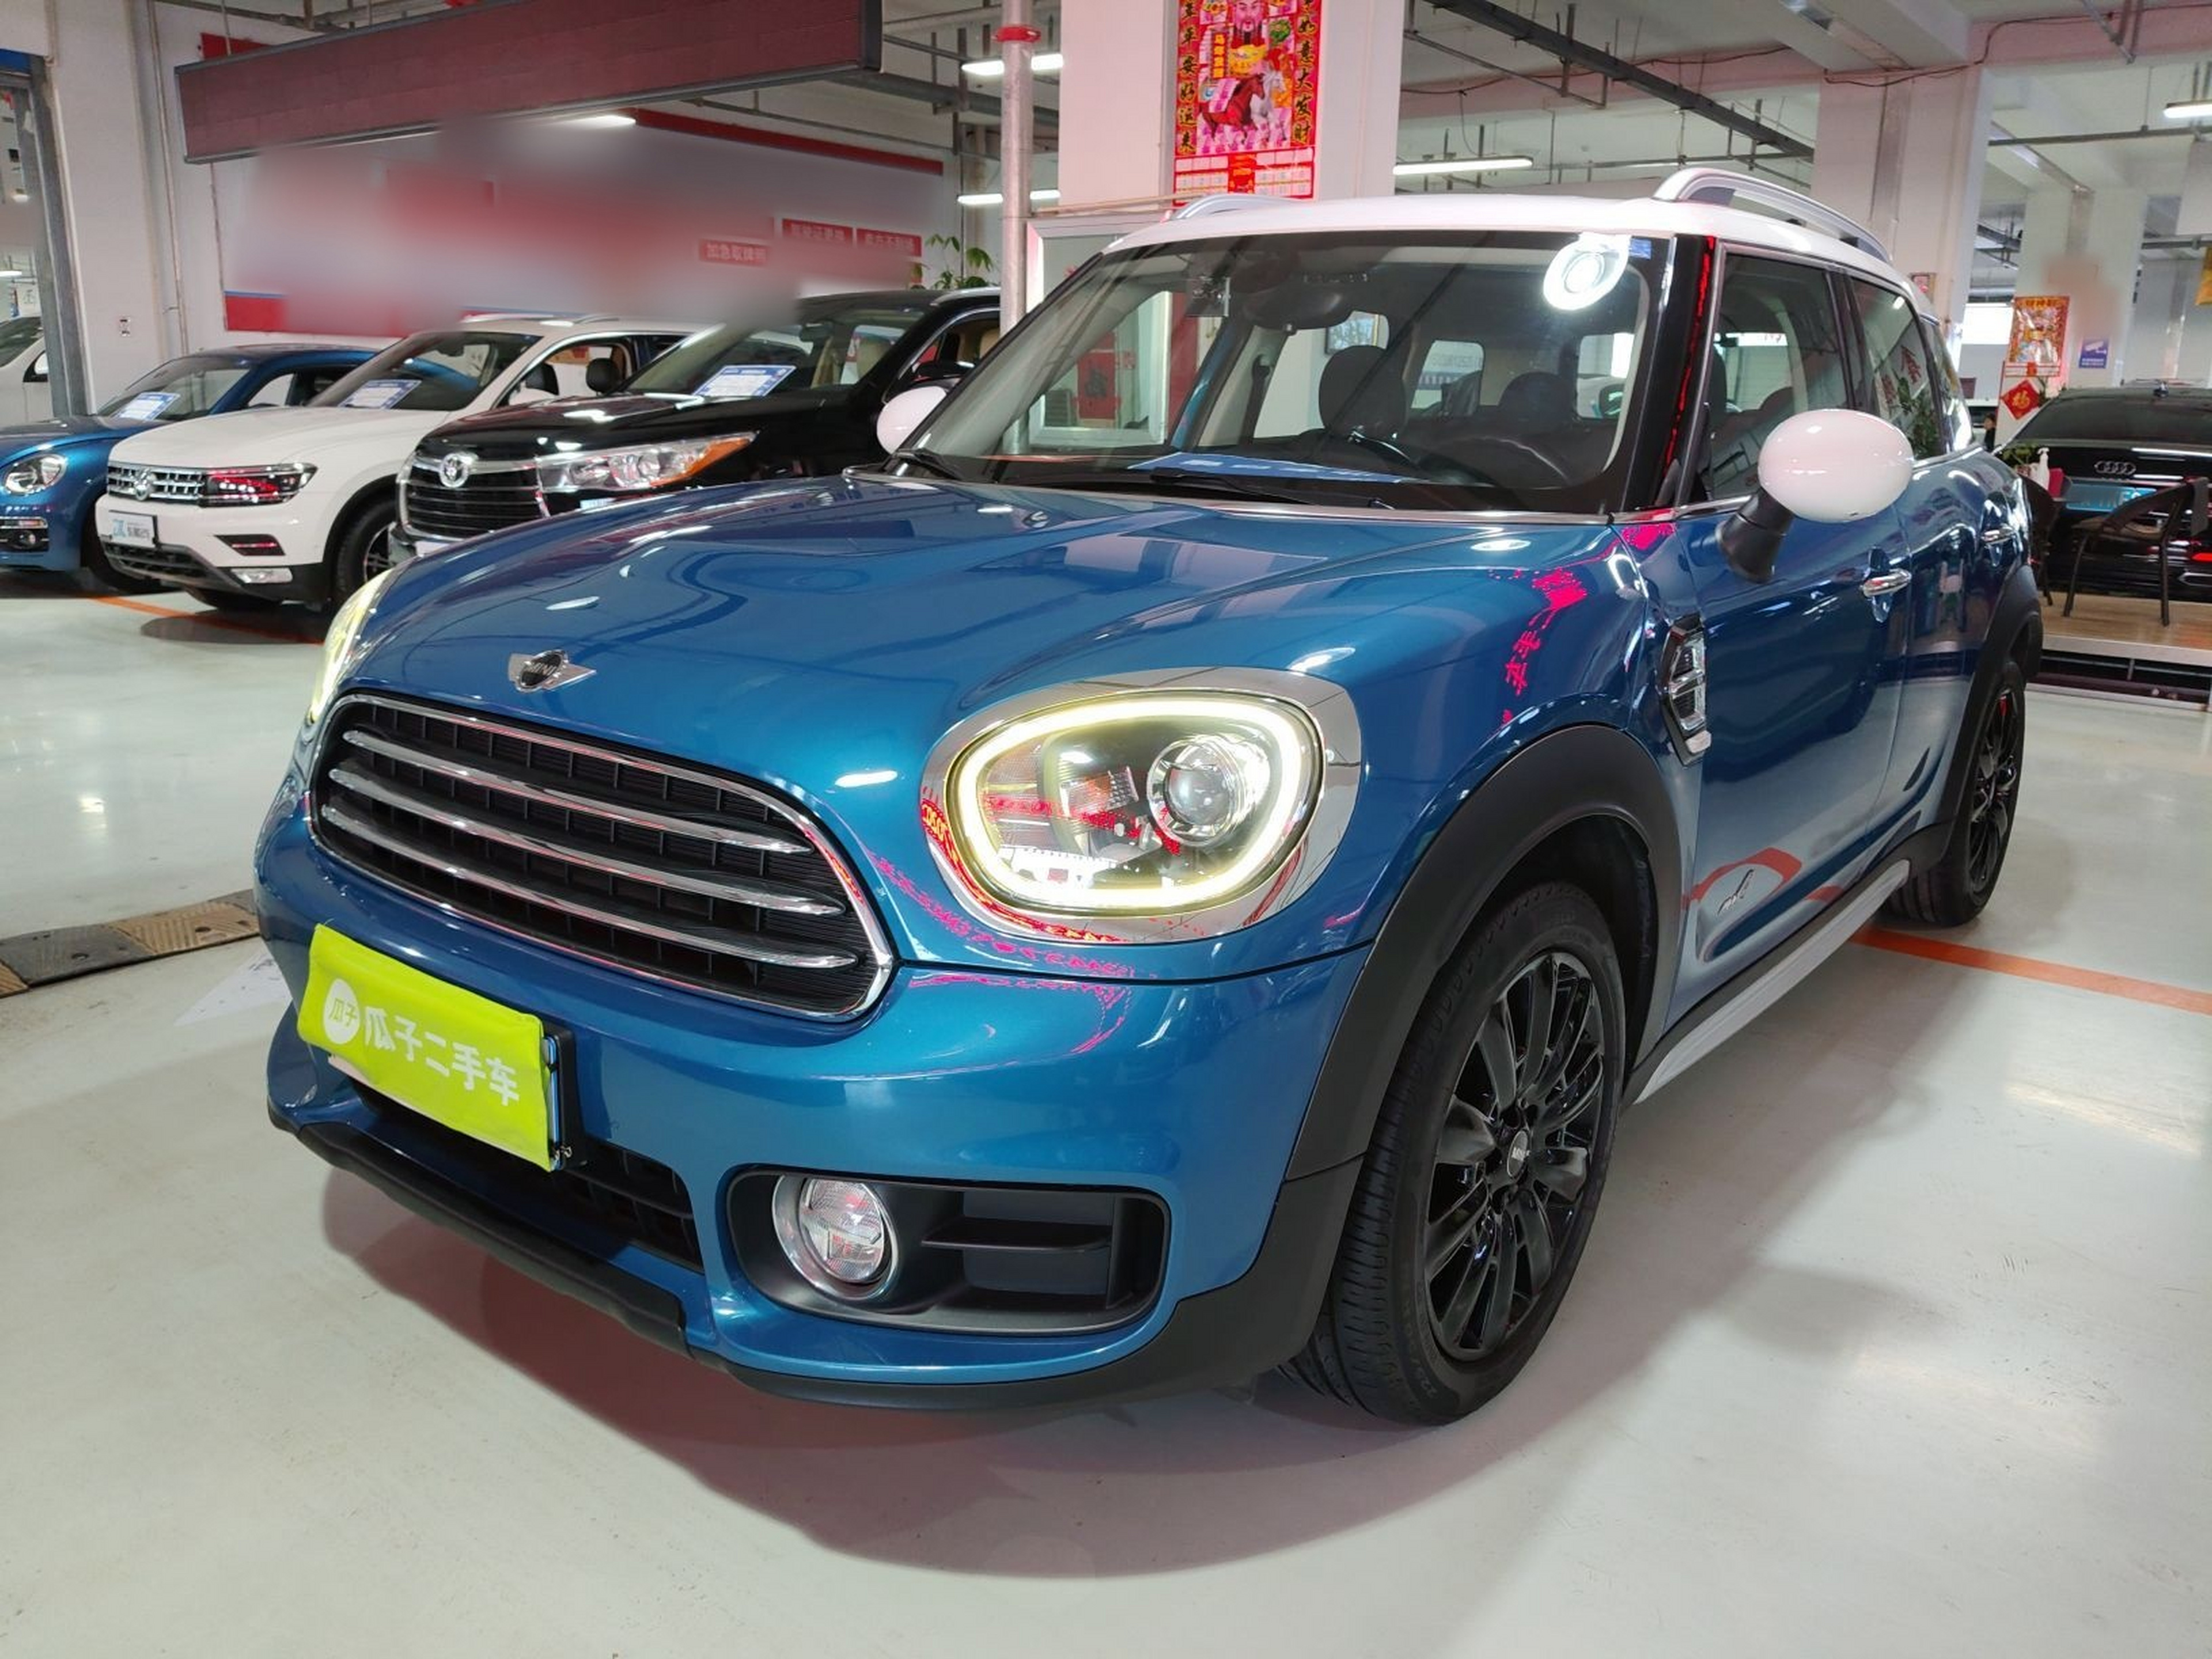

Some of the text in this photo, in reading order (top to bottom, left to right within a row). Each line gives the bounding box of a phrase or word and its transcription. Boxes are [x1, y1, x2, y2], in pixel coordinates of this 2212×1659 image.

[328, 997, 357, 1027] 瓜子
[365, 1006, 519, 1106] 瓜子二手车
